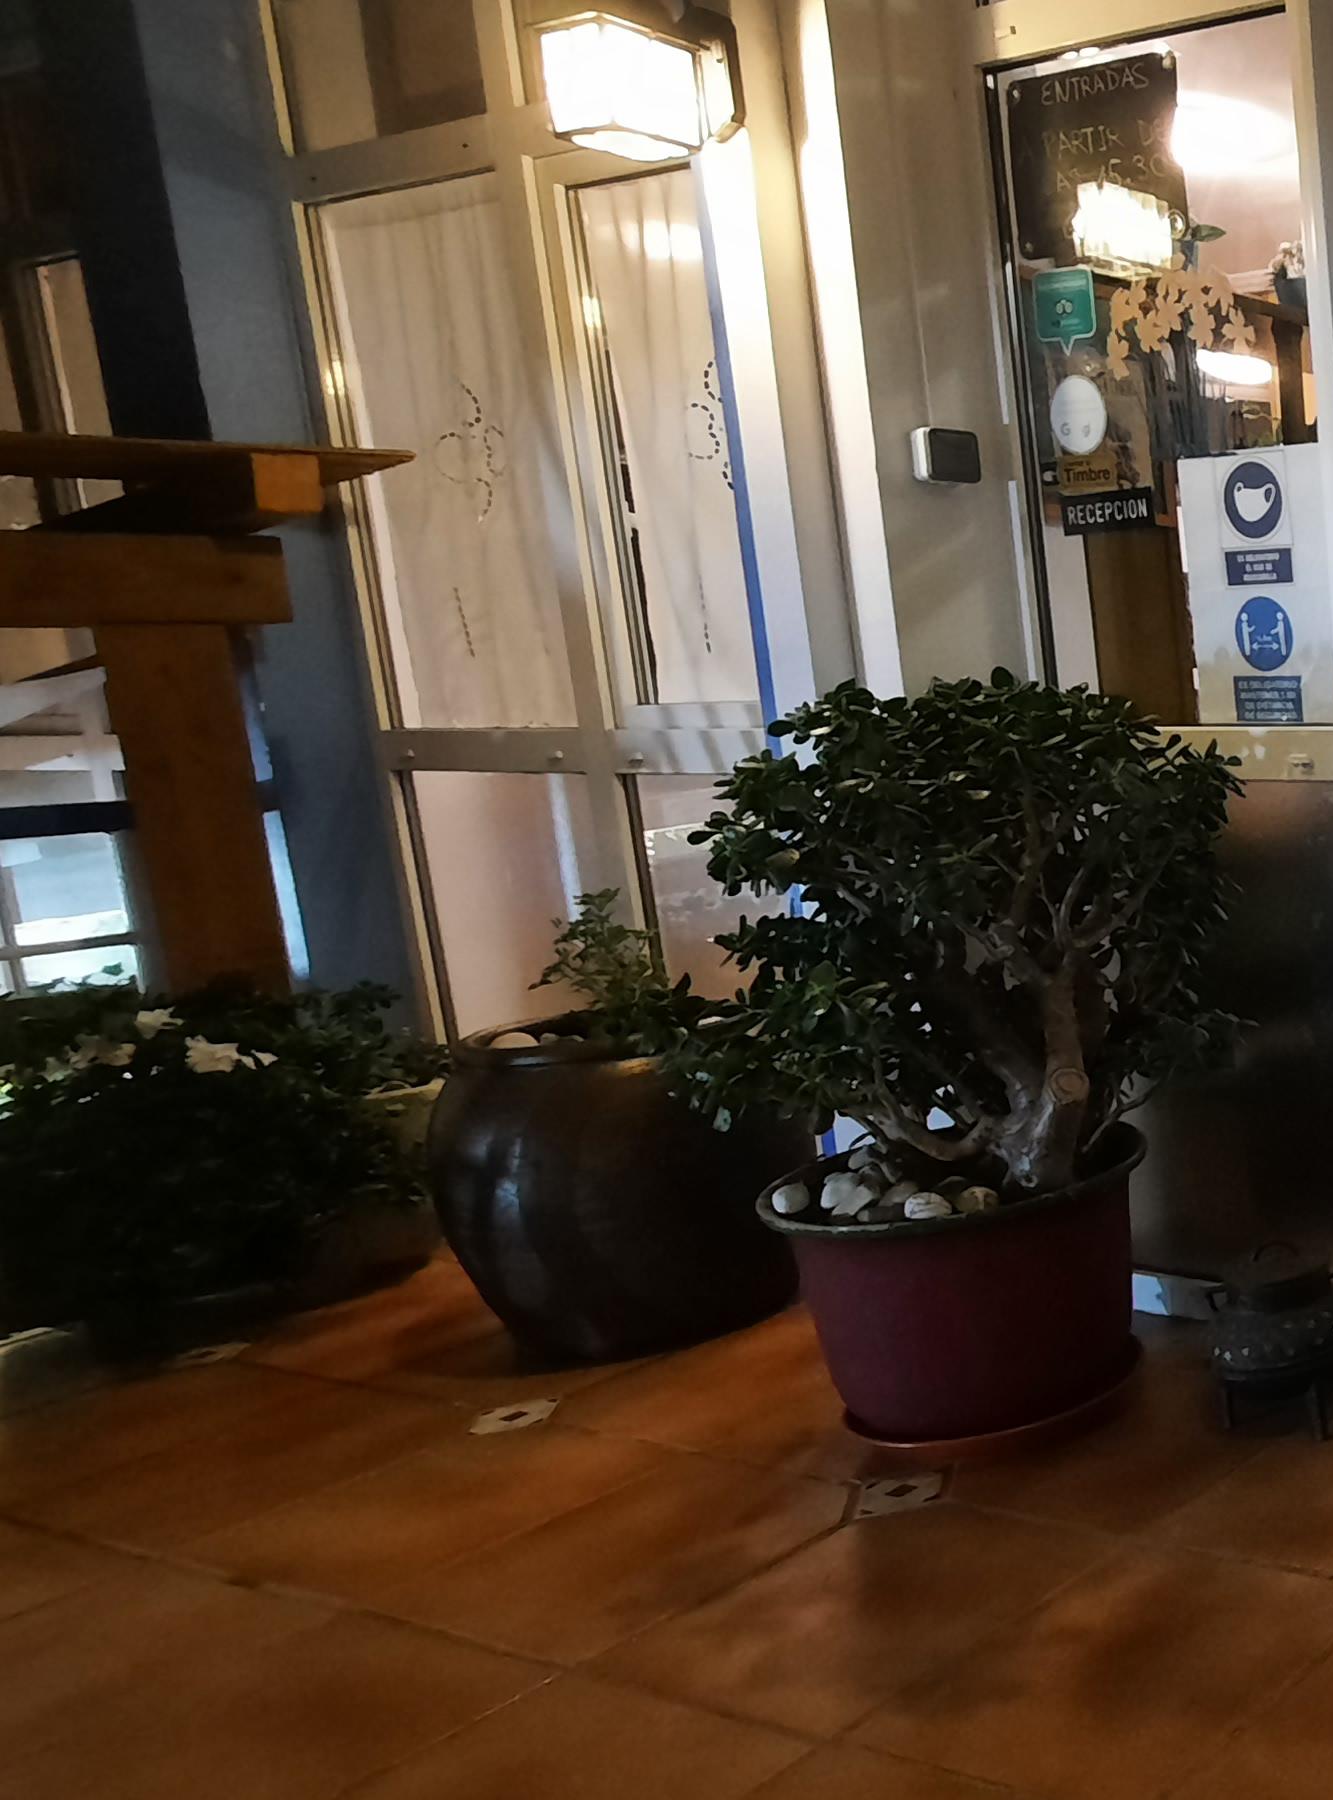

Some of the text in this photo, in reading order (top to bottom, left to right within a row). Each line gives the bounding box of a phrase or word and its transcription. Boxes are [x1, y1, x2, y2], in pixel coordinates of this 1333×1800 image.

[1041, 63, 1149, 106] ENTRADAS
[1042, 125, 1125, 160] PARTIR
[1064, 466, 1111, 483] Timbre
[1067, 498, 1149, 526] RECEPCION
